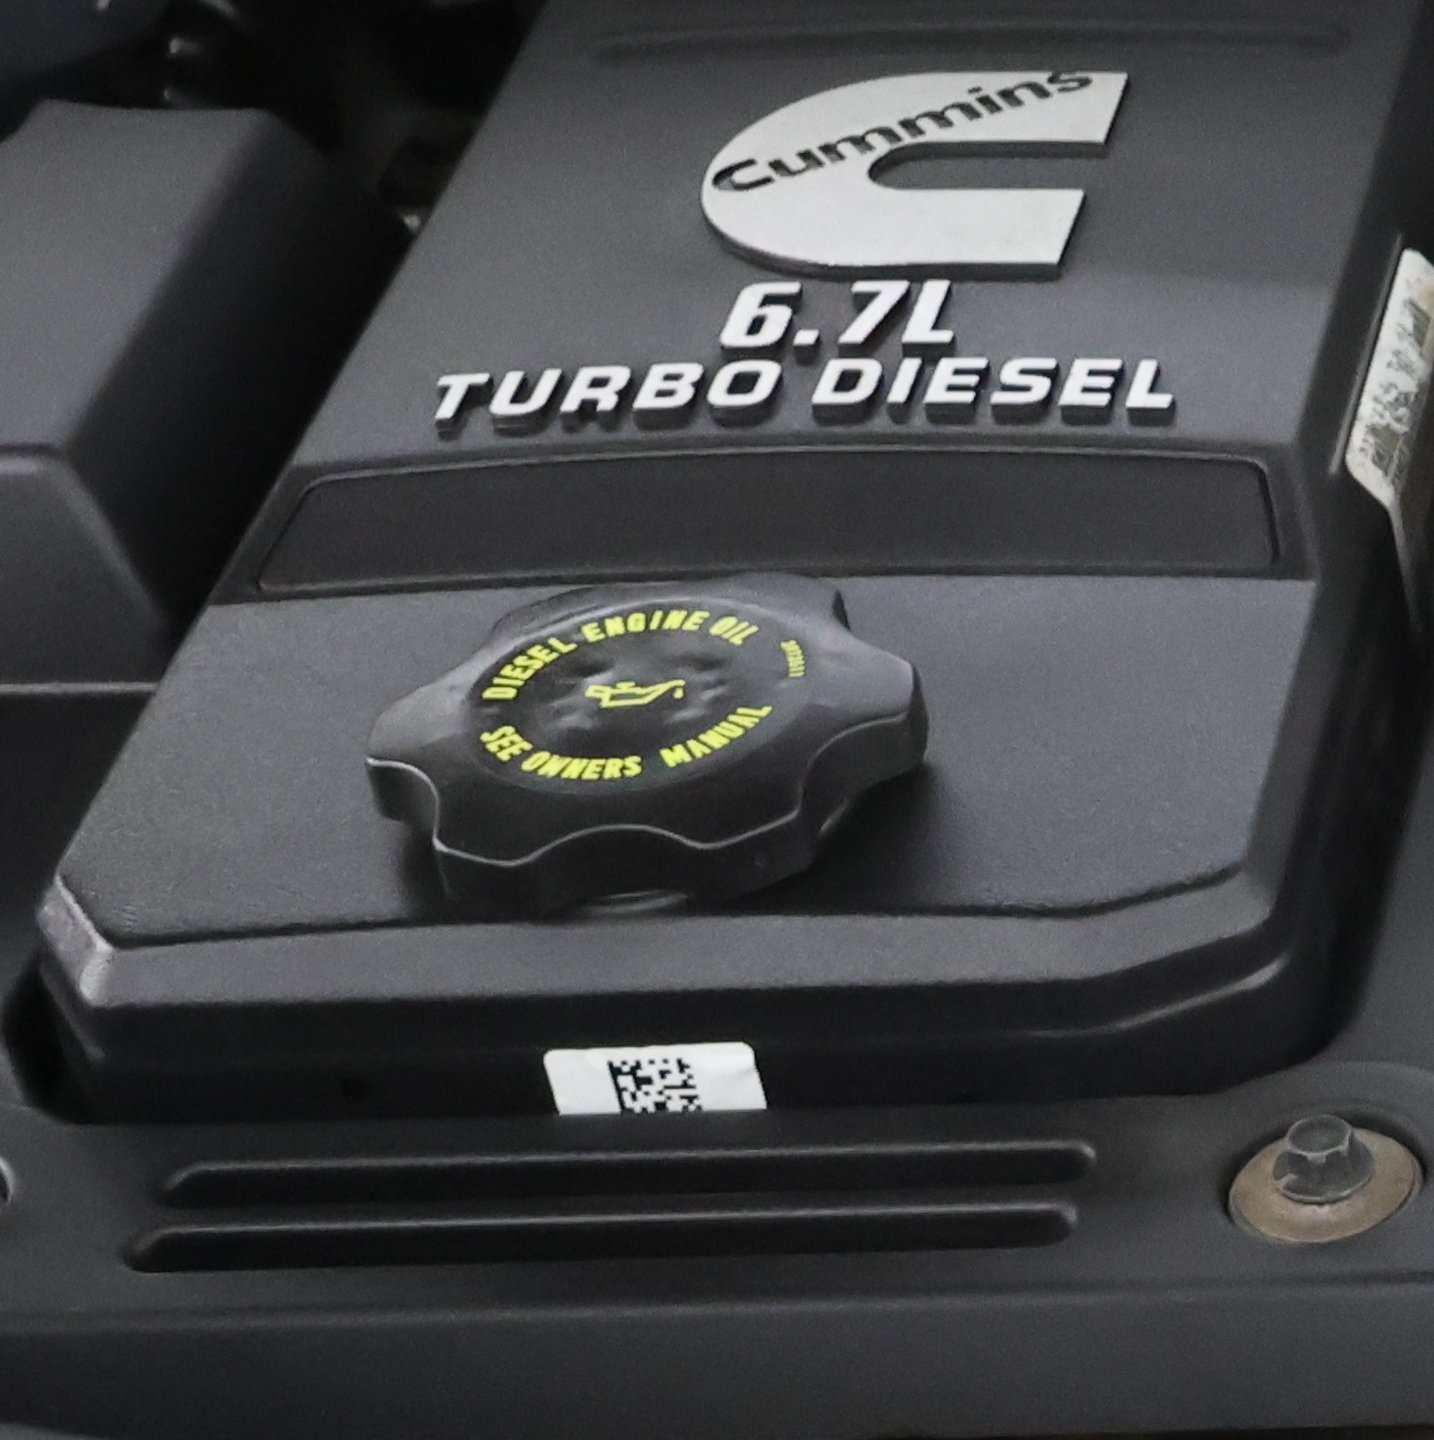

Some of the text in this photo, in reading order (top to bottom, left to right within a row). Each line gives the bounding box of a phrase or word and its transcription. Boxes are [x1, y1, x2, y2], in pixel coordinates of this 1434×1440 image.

[711, 69, 1094, 193] Cummins
[719, 279, 955, 350] 6.7L
[434, 356, 1175, 426] TURBO DIESEL
[481, 610, 759, 702] DIESEL ENGINE OIL
[480, 705, 773, 779] SEE OWNERS MANUAL
